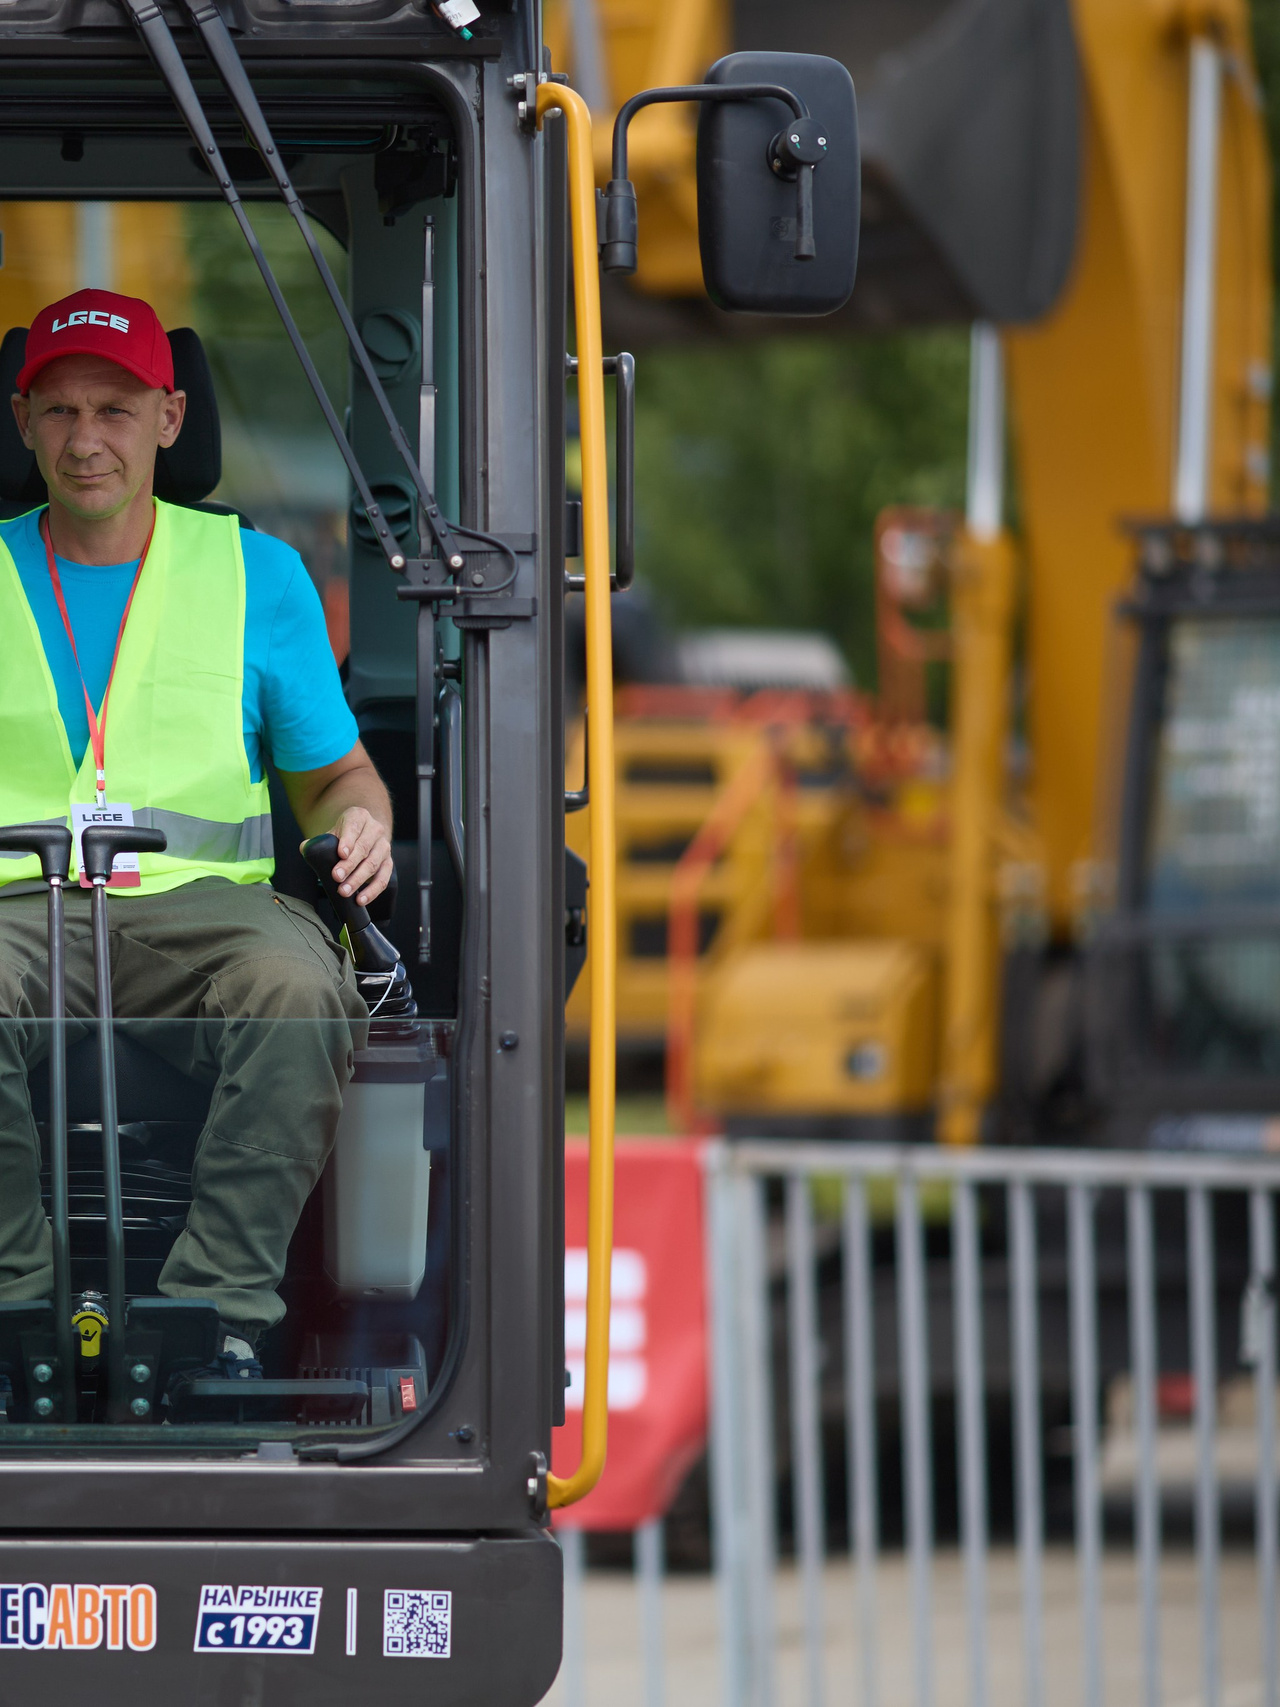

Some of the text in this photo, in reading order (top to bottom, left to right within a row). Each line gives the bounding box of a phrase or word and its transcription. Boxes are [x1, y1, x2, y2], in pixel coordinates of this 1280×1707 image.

[51, 310, 130, 334] LGCE
[81, 813, 123, 822] LGCE
[203, 1588, 320, 1608] НА РЫНКЕ
[230, 1615, 305, 1646] 1993
